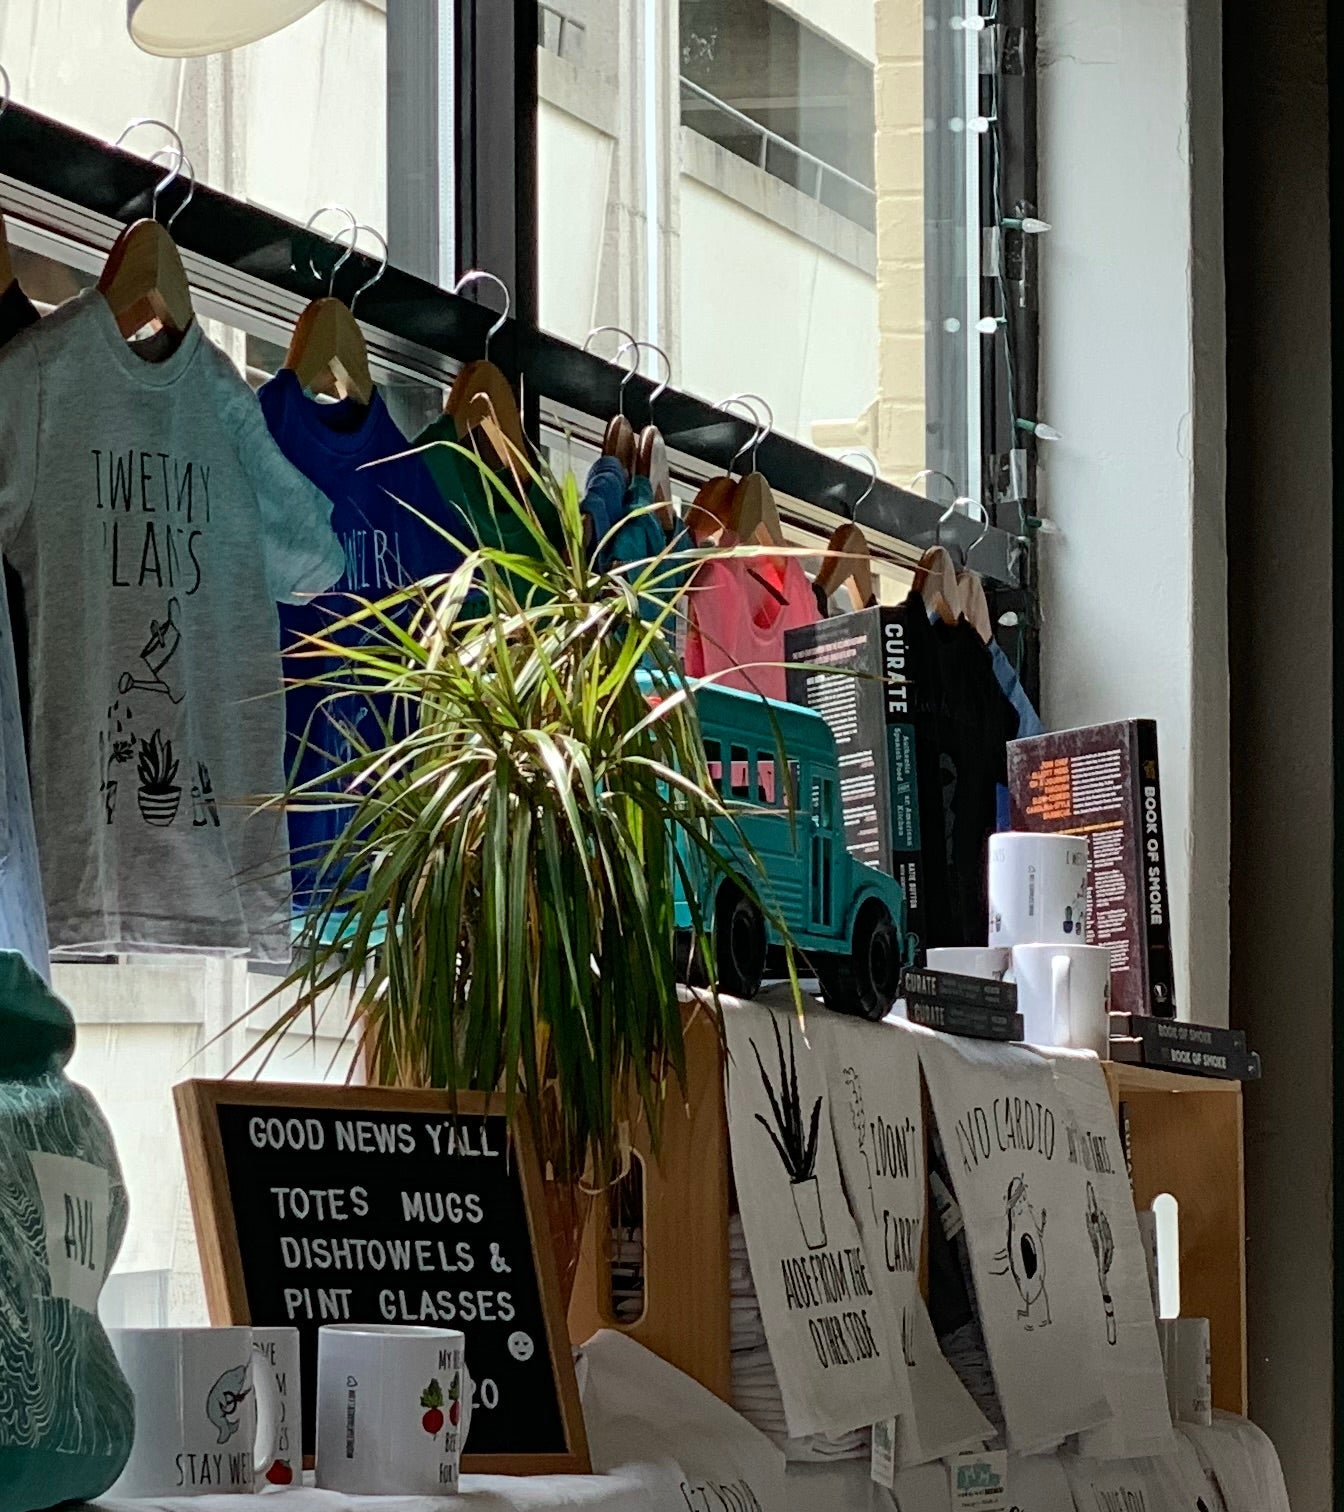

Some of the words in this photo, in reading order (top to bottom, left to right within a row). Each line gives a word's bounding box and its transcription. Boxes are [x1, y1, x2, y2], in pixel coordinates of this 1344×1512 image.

[1143, 786, 1156, 834] BOOK
[1146, 840, 1159, 864] OF
[1148, 867, 1163, 926] SMOKE
[1170, 1047, 1190, 1064] BOOK
[1202, 1052, 1228, 1070] SMOKE
[248, 1117, 325, 1151] GOOD
[336, 1120, 416, 1155] NEWS
[425, 1121, 499, 1157] Y'ALL
[992, 1096, 1055, 1161] CARDIO
[270, 1186, 369, 1221] TOTES
[401, 1191, 484, 1224] MUGS
[280, 1237, 475, 1273] DISHTOWELS
[490, 1243, 511, 1273] &
[284, 1288, 352, 1320] PINT
[379, 1290, 516, 1322] GLASSES
[175, 1453, 223, 1486] STAY
